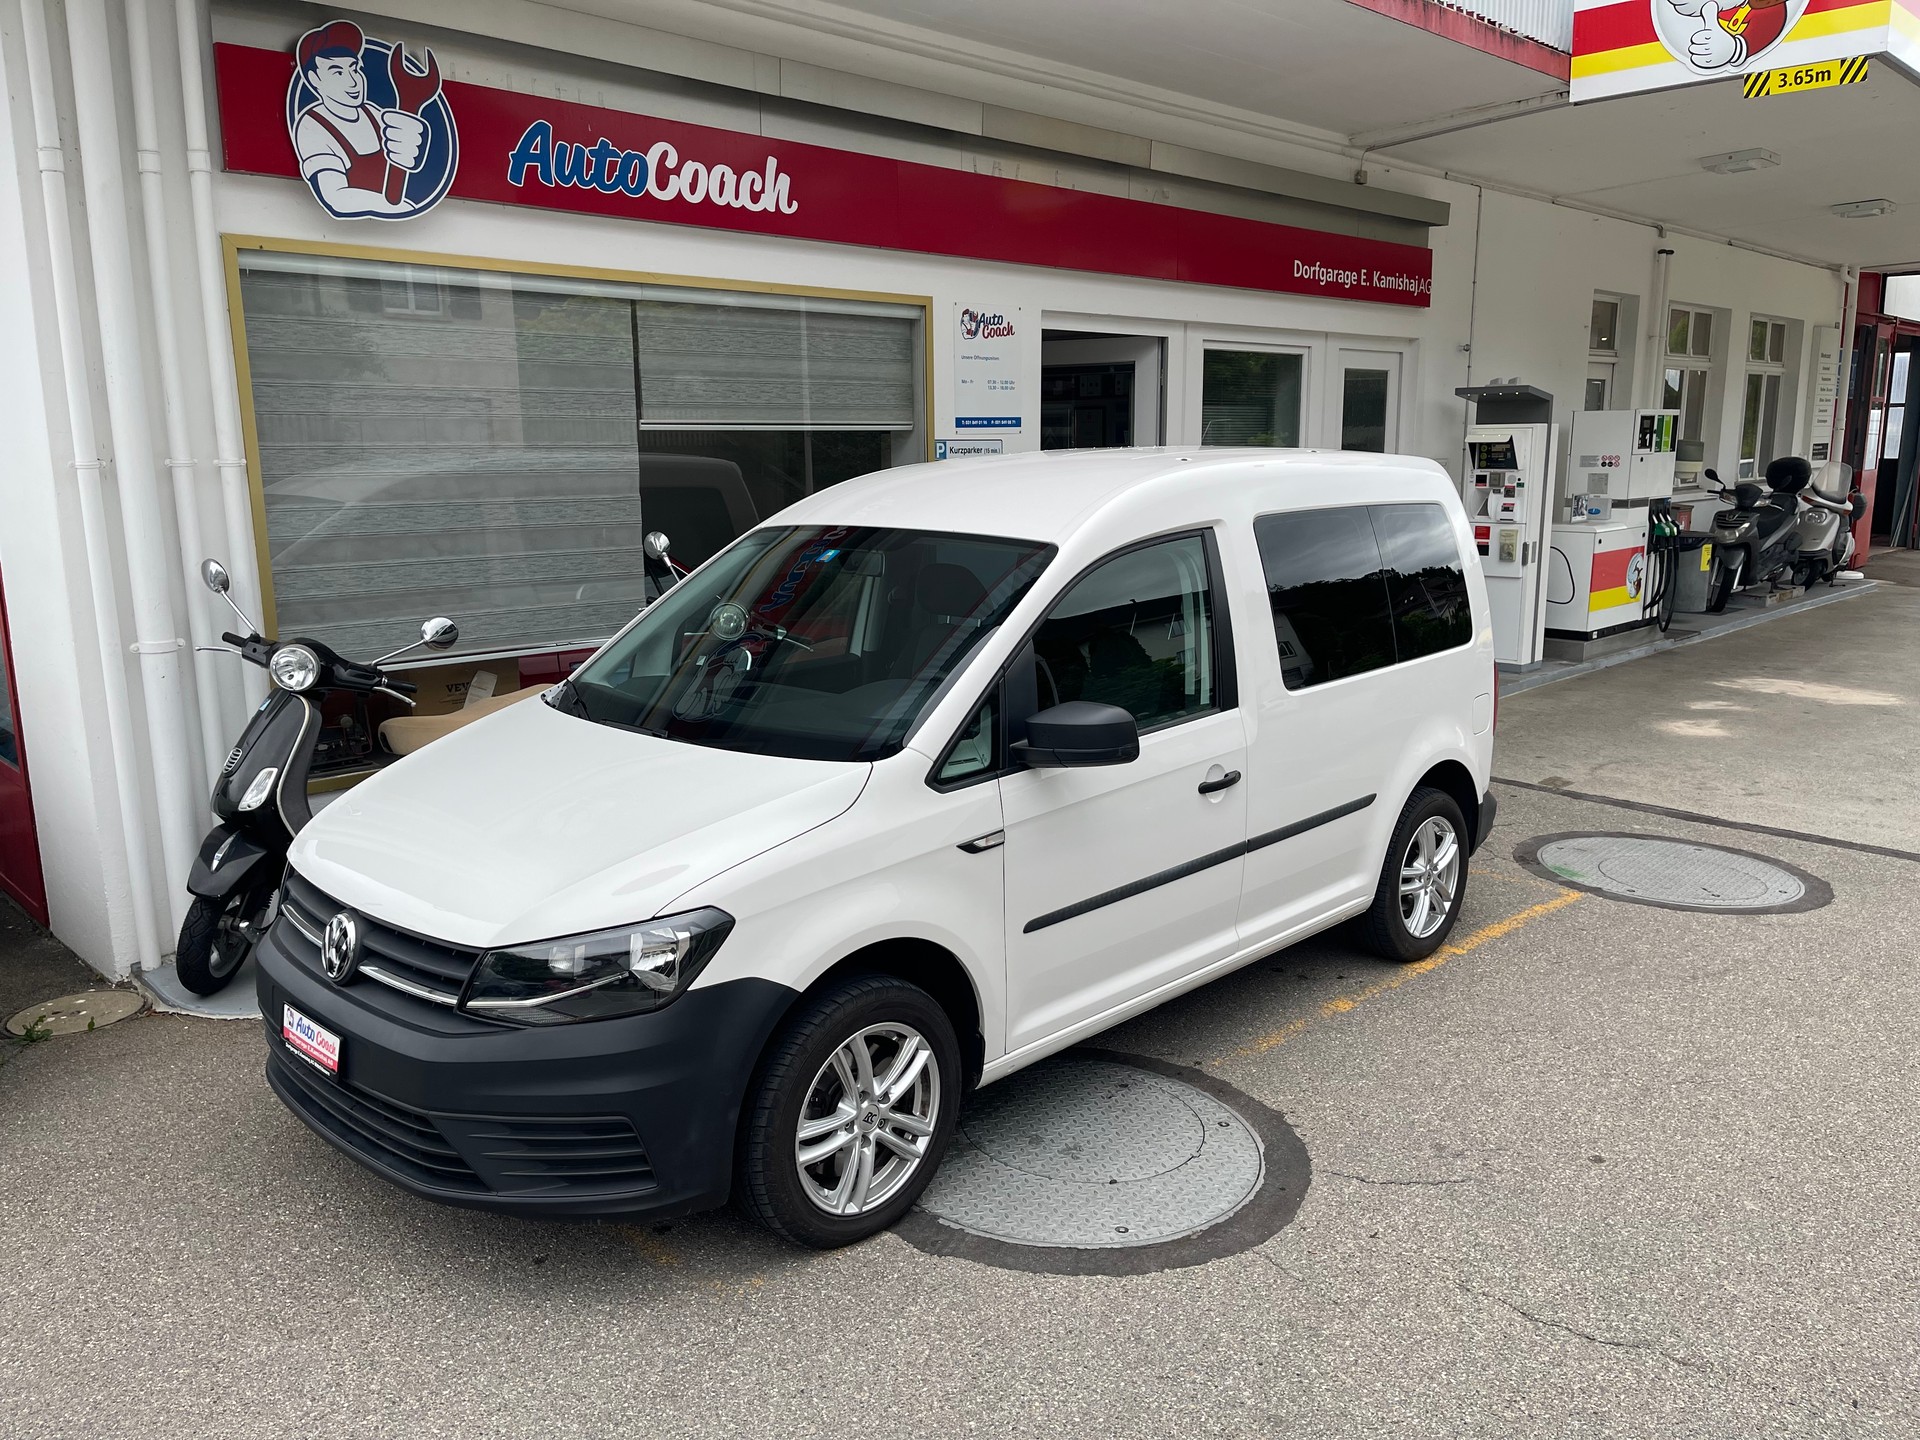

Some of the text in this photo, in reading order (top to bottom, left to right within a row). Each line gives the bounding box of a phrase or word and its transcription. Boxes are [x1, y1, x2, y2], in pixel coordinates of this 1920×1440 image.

[1778, 68, 1831, 88] 3.65m
[1293, 259, 1358, 288] Dorfgarage
[1360, 269, 1370, 286] E.
[978, 312, 1004, 326] Auto
[982, 321, 1016, 339] Coach
[936, 442, 945, 458] P
[949, 446, 983, 455] Kurzparker
[296, 1016, 336, 1055] Auto Coach
